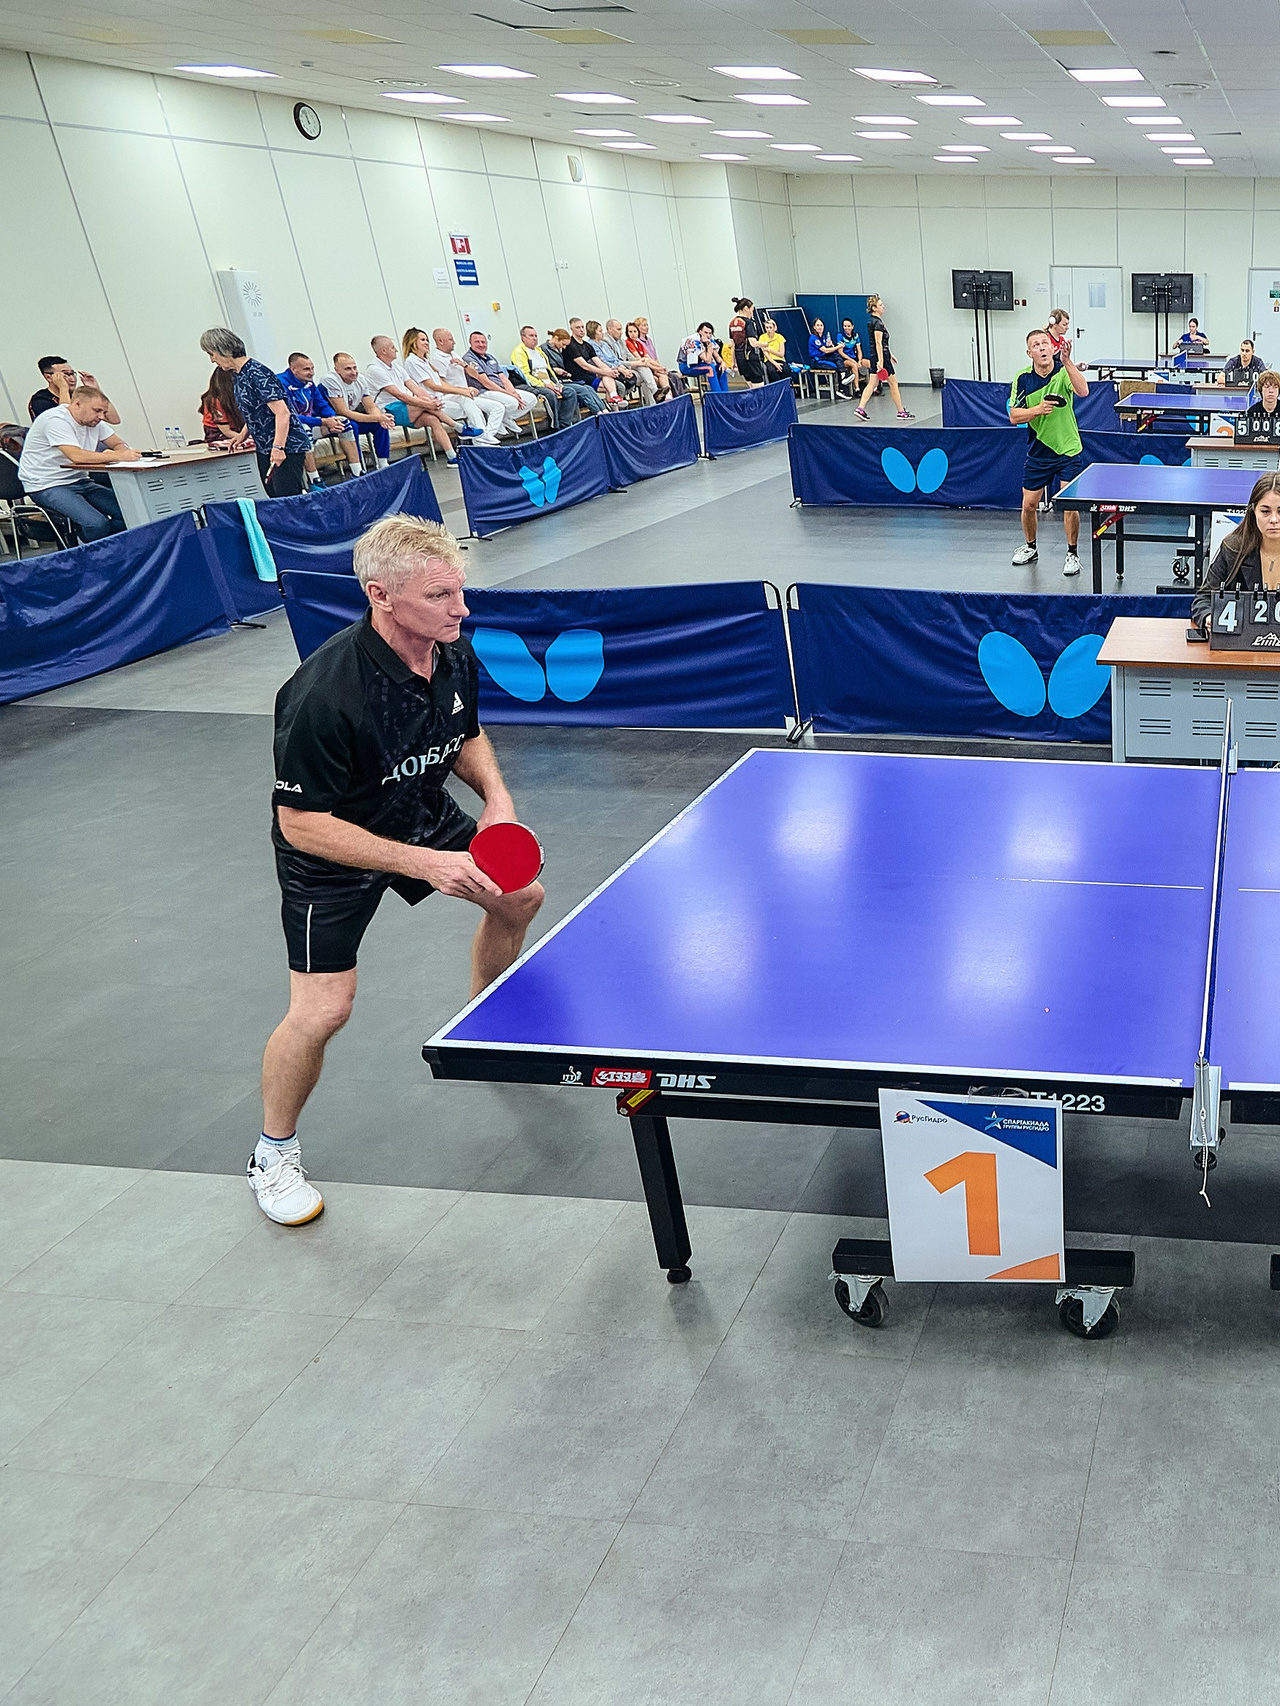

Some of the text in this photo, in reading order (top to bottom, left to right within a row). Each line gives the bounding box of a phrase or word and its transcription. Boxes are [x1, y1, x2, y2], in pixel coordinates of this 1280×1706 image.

[1238, 420, 1247, 436] 5
[1218, 601, 1238, 632] 4
[655, 1073, 717, 1089] DHS
[1002, 1118, 1050, 1127] СПАРТАКИАДА
[923, 1151, 1001, 1256] 1
